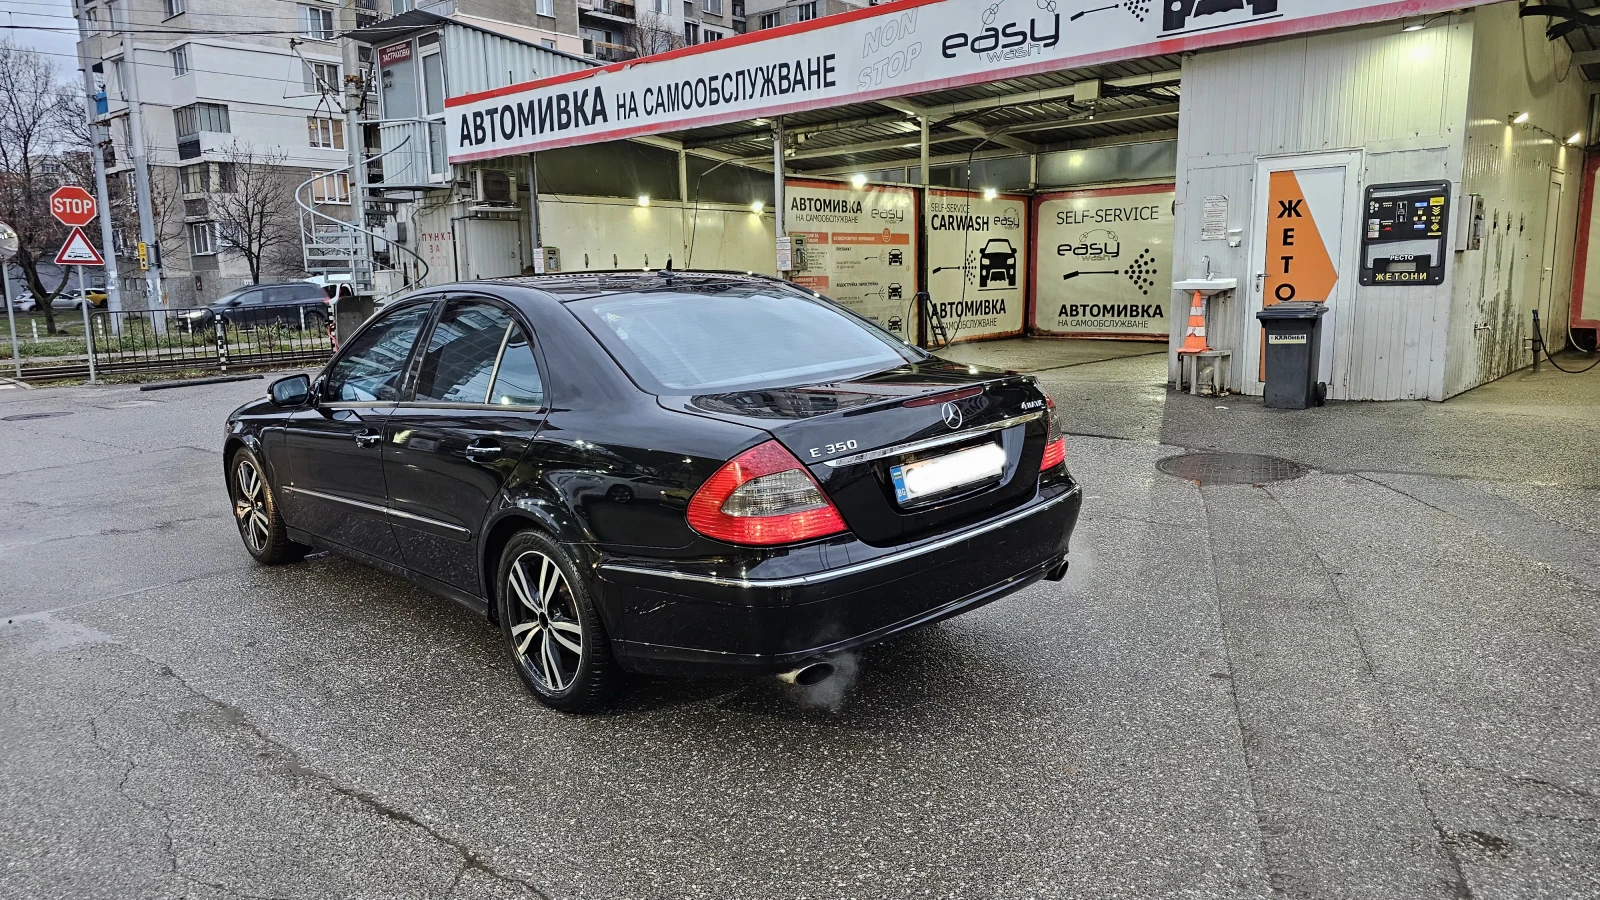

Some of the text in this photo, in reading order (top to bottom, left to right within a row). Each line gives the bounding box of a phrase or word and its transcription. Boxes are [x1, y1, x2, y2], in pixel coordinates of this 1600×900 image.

[862, 7, 918, 58] NON
[941, 13, 1060, 59] easy
[986, 42, 1041, 63] wash
[856, 41, 923, 93] STOP
[459, 53, 836, 148] АВТОМИВКА НА САМООБСЛУЖВАНЕ
[53, 197, 93, 215] STOP
[790, 197, 863, 214] АВТОМИВКА
[930, 202, 971, 214] SELF-SERVICE
[795, 213, 859, 224] НА САМООБСЛУЖВАНЕ
[870, 207, 904, 222] easy
[931, 213, 990, 232] CARWASH
[993, 215, 1020, 229] easy
[1056, 206, 1160, 225] SELF-SERVICE
[421, 231, 452, 242] ПУНКТ
[429, 244, 441, 253] ЗА
[1057, 241, 1120, 258] easy
[1375, 272, 1427, 281] ЖЕТОНИ
[931, 299, 1006, 319] АВТОМИВКА
[1058, 304, 1164, 318] АВТОМИВКА
[1070, 320, 1149, 328] САМООБСЛУЖВАНЕ
[809, 439, 858, 458] E 350
